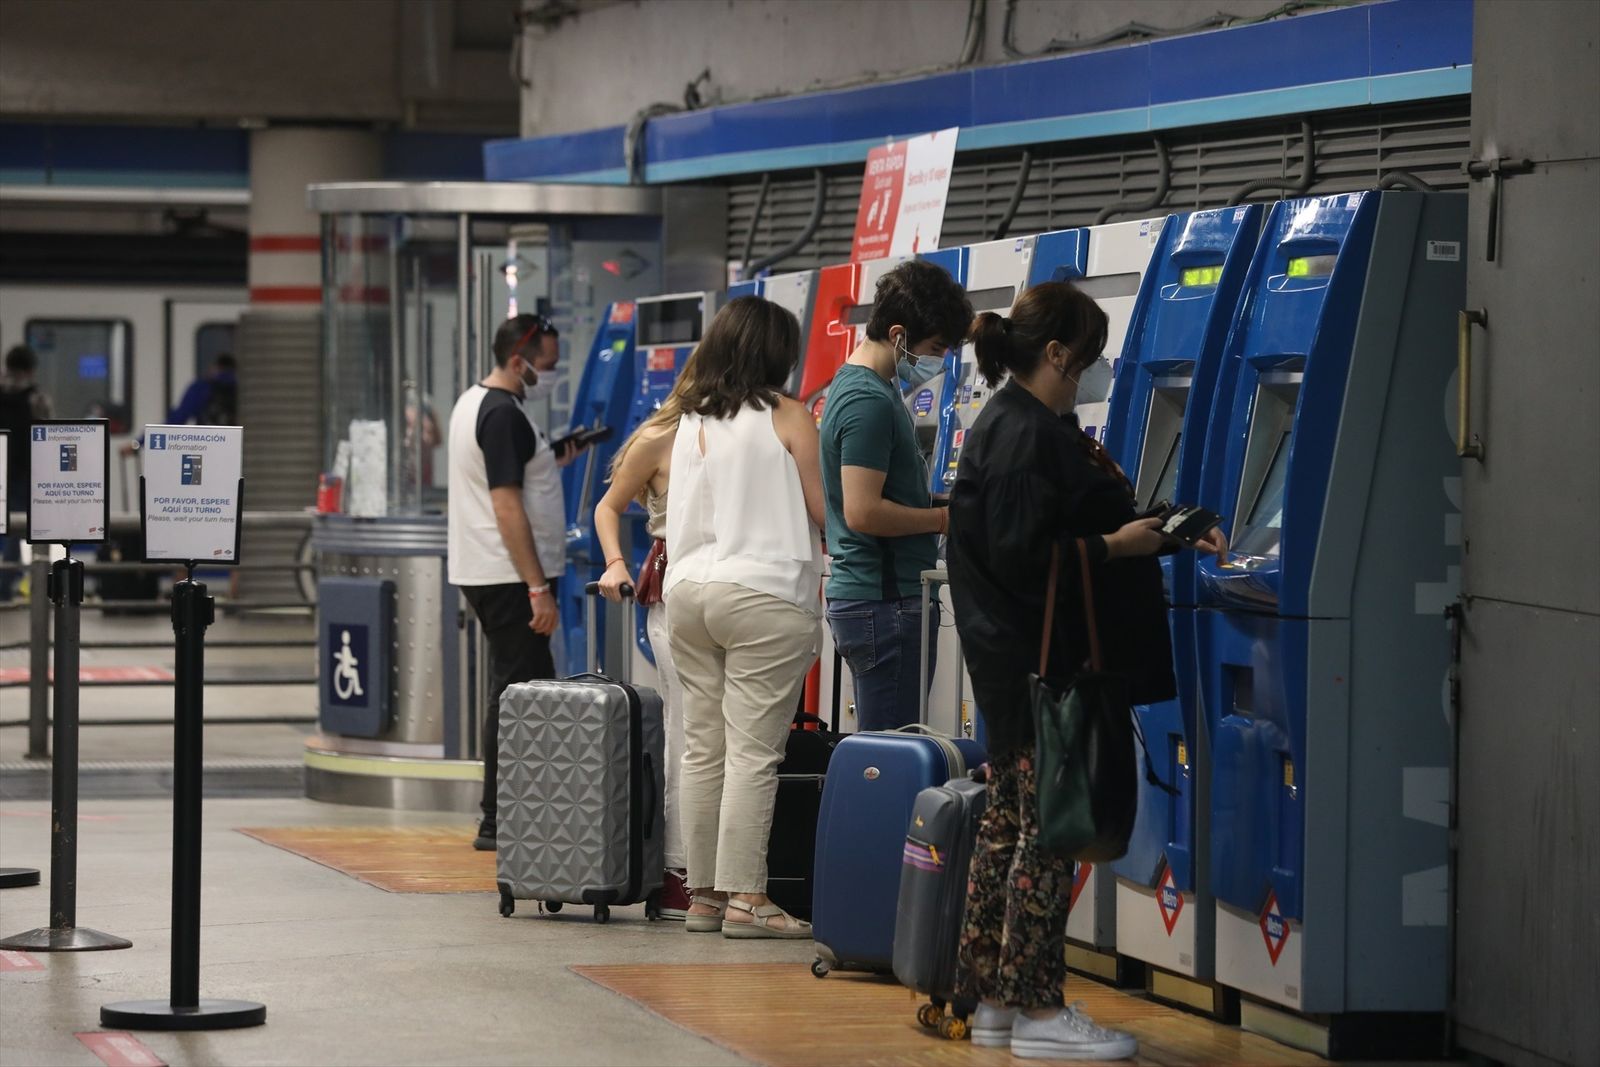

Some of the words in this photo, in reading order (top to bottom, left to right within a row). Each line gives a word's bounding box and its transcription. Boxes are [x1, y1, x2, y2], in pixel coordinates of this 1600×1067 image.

[168, 433, 226, 442] INFORMACIÓN
[1163, 889, 1178, 908] Metro
[1267, 915, 1283, 937] Metro
